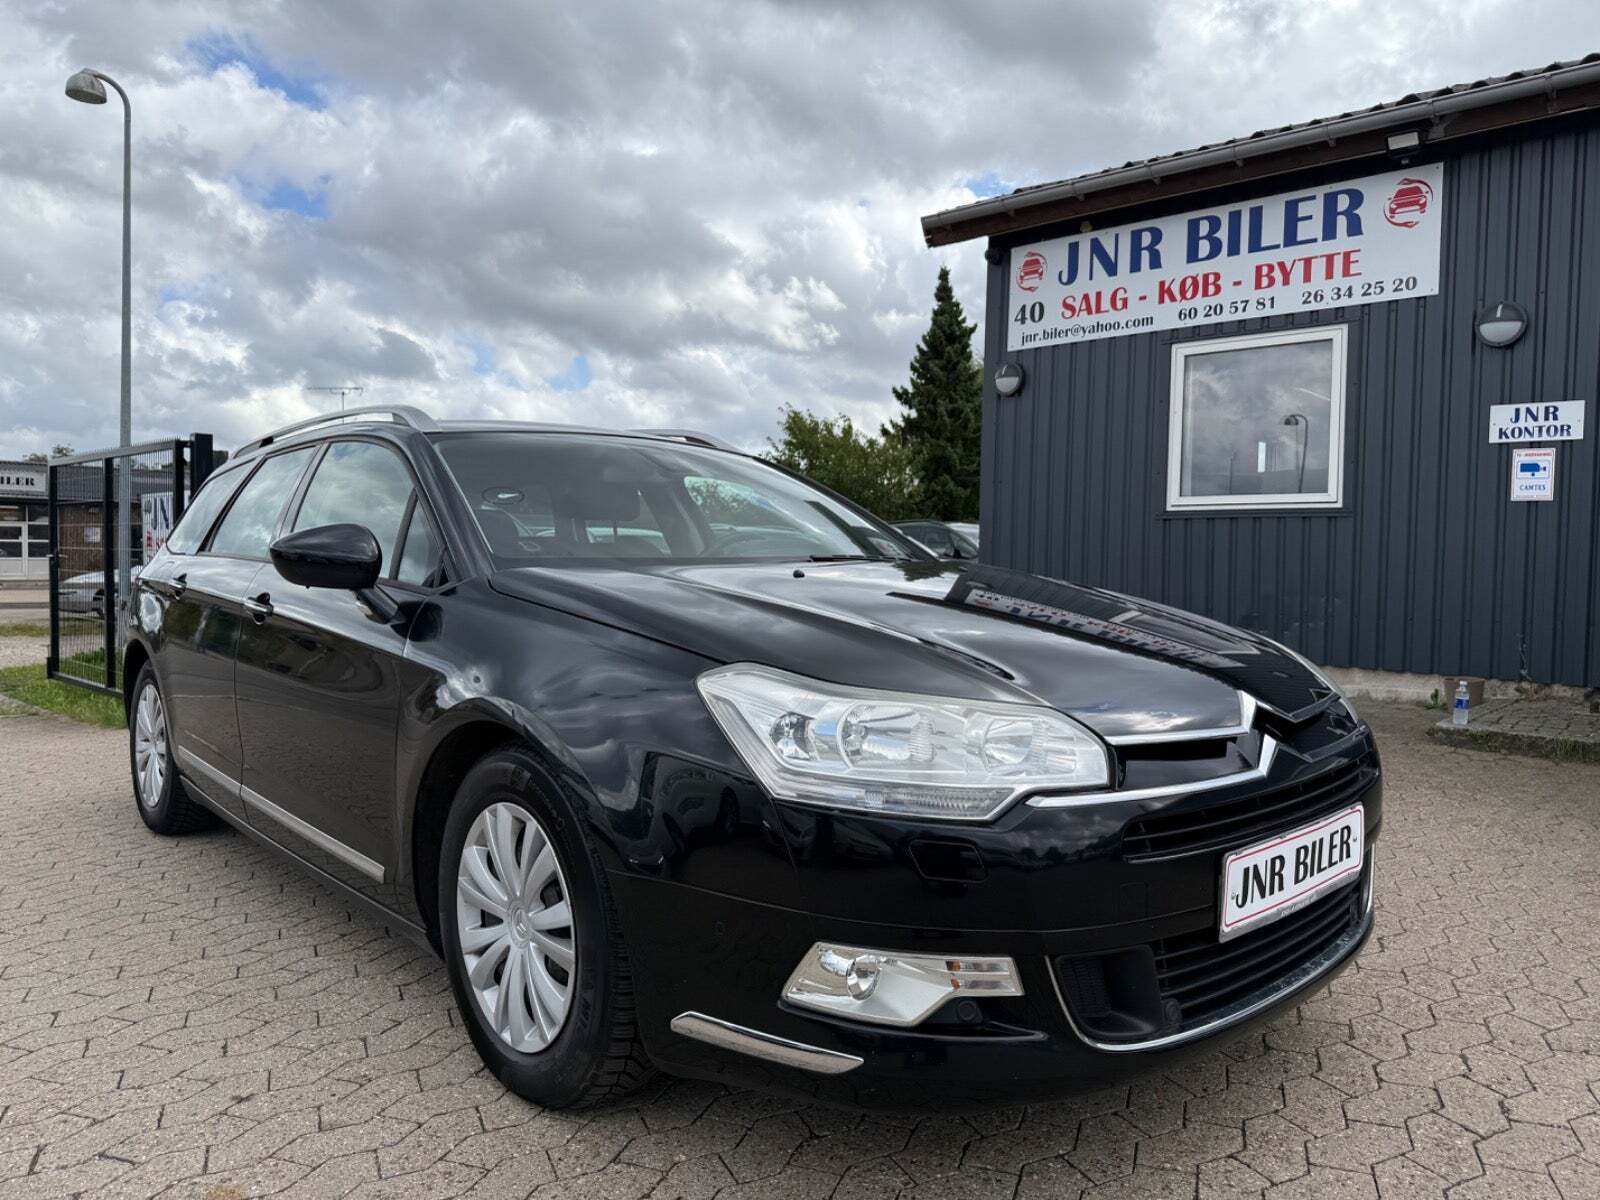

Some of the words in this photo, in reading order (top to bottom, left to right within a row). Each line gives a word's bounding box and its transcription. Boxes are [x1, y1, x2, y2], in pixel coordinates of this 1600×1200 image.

[1058, 226, 1163, 286] JNR
[1186, 188, 1364, 264] BILER
[1061, 287, 1129, 320] SALG
[1157, 272, 1222, 305] KØB
[1254, 249, 1362, 291] BYTTE
[1178, 307, 1198, 321] 60
[1203, 303, 1223, 318] 20
[1229, 299, 1250, 314] 57
[1256, 296, 1275, 311] 81
[1302, 289, 1324, 305] 26
[1331, 285, 1354, 301] 34
[1361, 281, 1385, 297] 25
[1392, 276, 1417, 292] 20
[1014, 301, 1045, 325] 40
[1021, 315, 1154, 346] jnr.biler@yahoo.com
[1498, 424, 1572, 440] KONTOR
[1510, 405, 1559, 424] JNR
[1235, 854, 1286, 909] JNR
[1293, 825, 1352, 885] BILER
